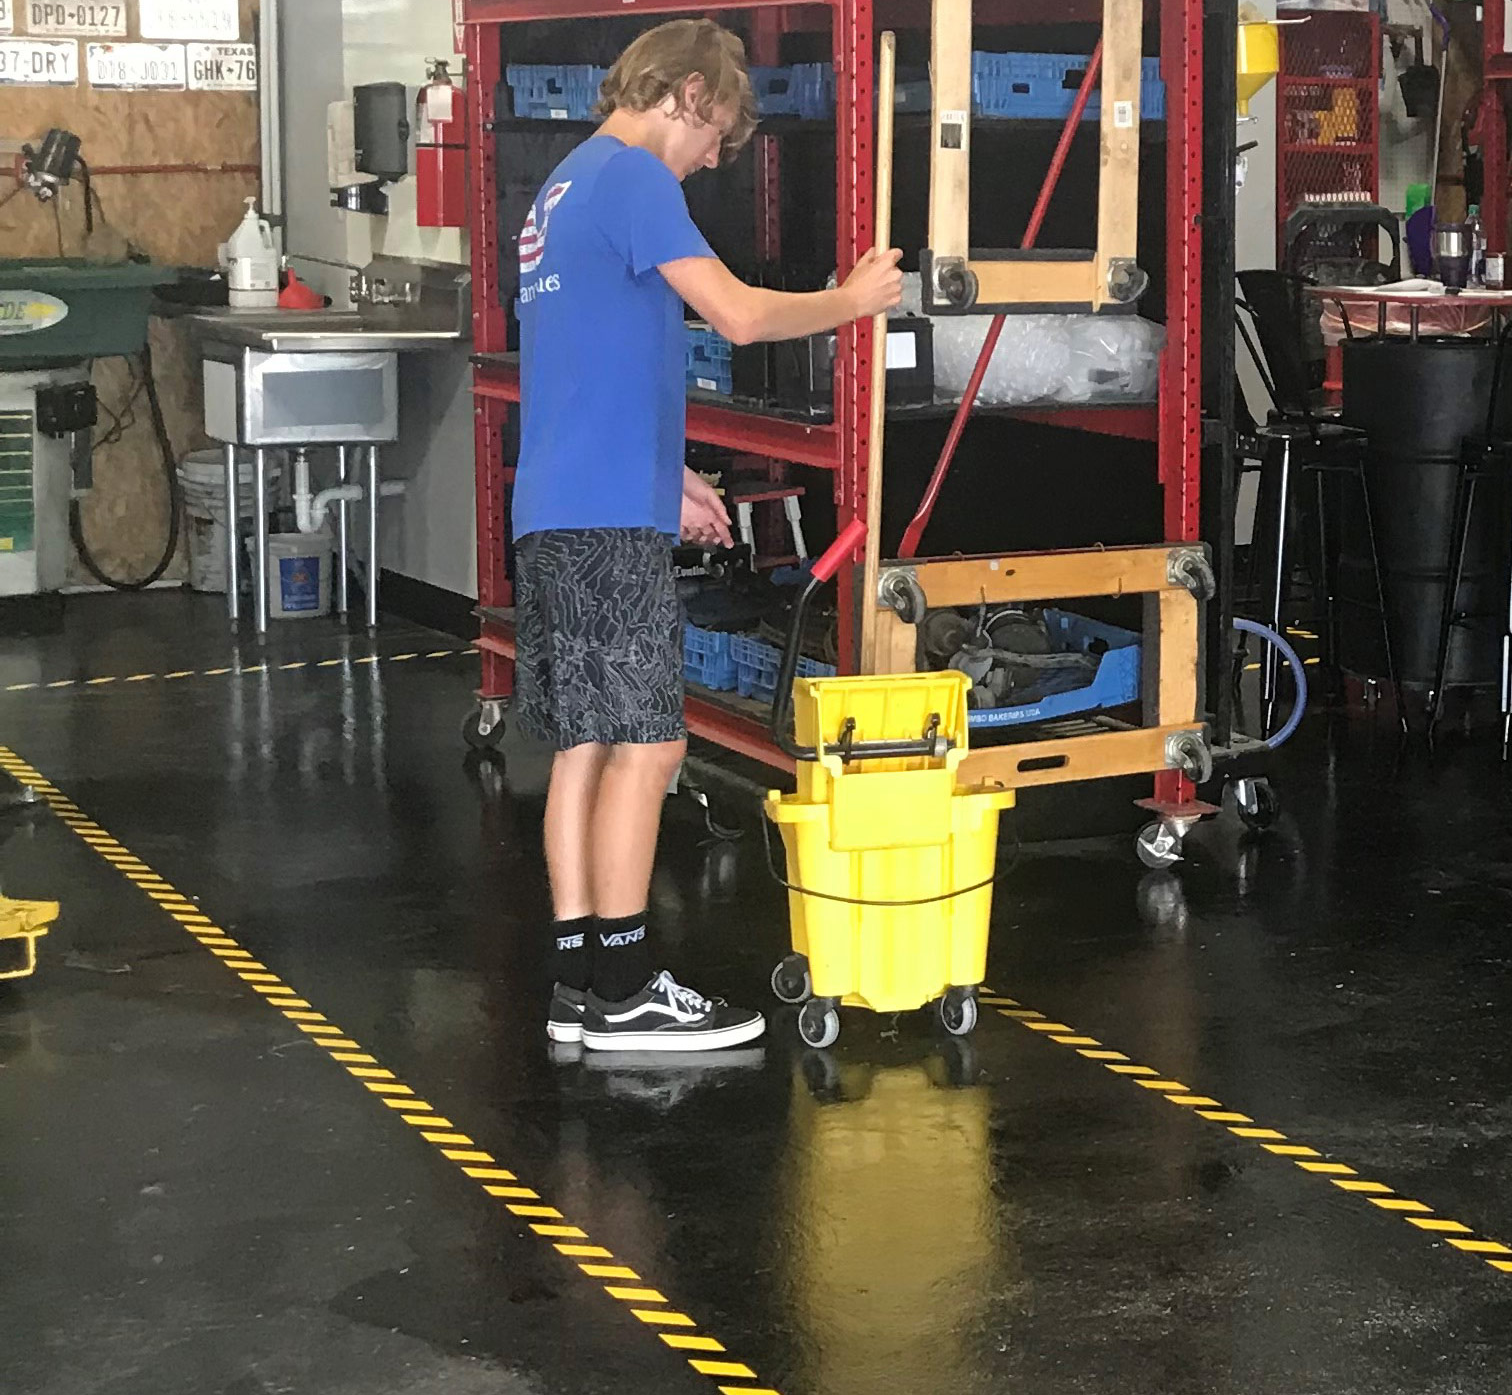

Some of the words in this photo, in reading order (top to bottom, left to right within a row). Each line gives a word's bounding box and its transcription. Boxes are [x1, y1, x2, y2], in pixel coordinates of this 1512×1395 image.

[216, 47, 254, 56] TEXAS
[556, 932, 584, 951] NS
[600, 924, 646, 948] VANS
